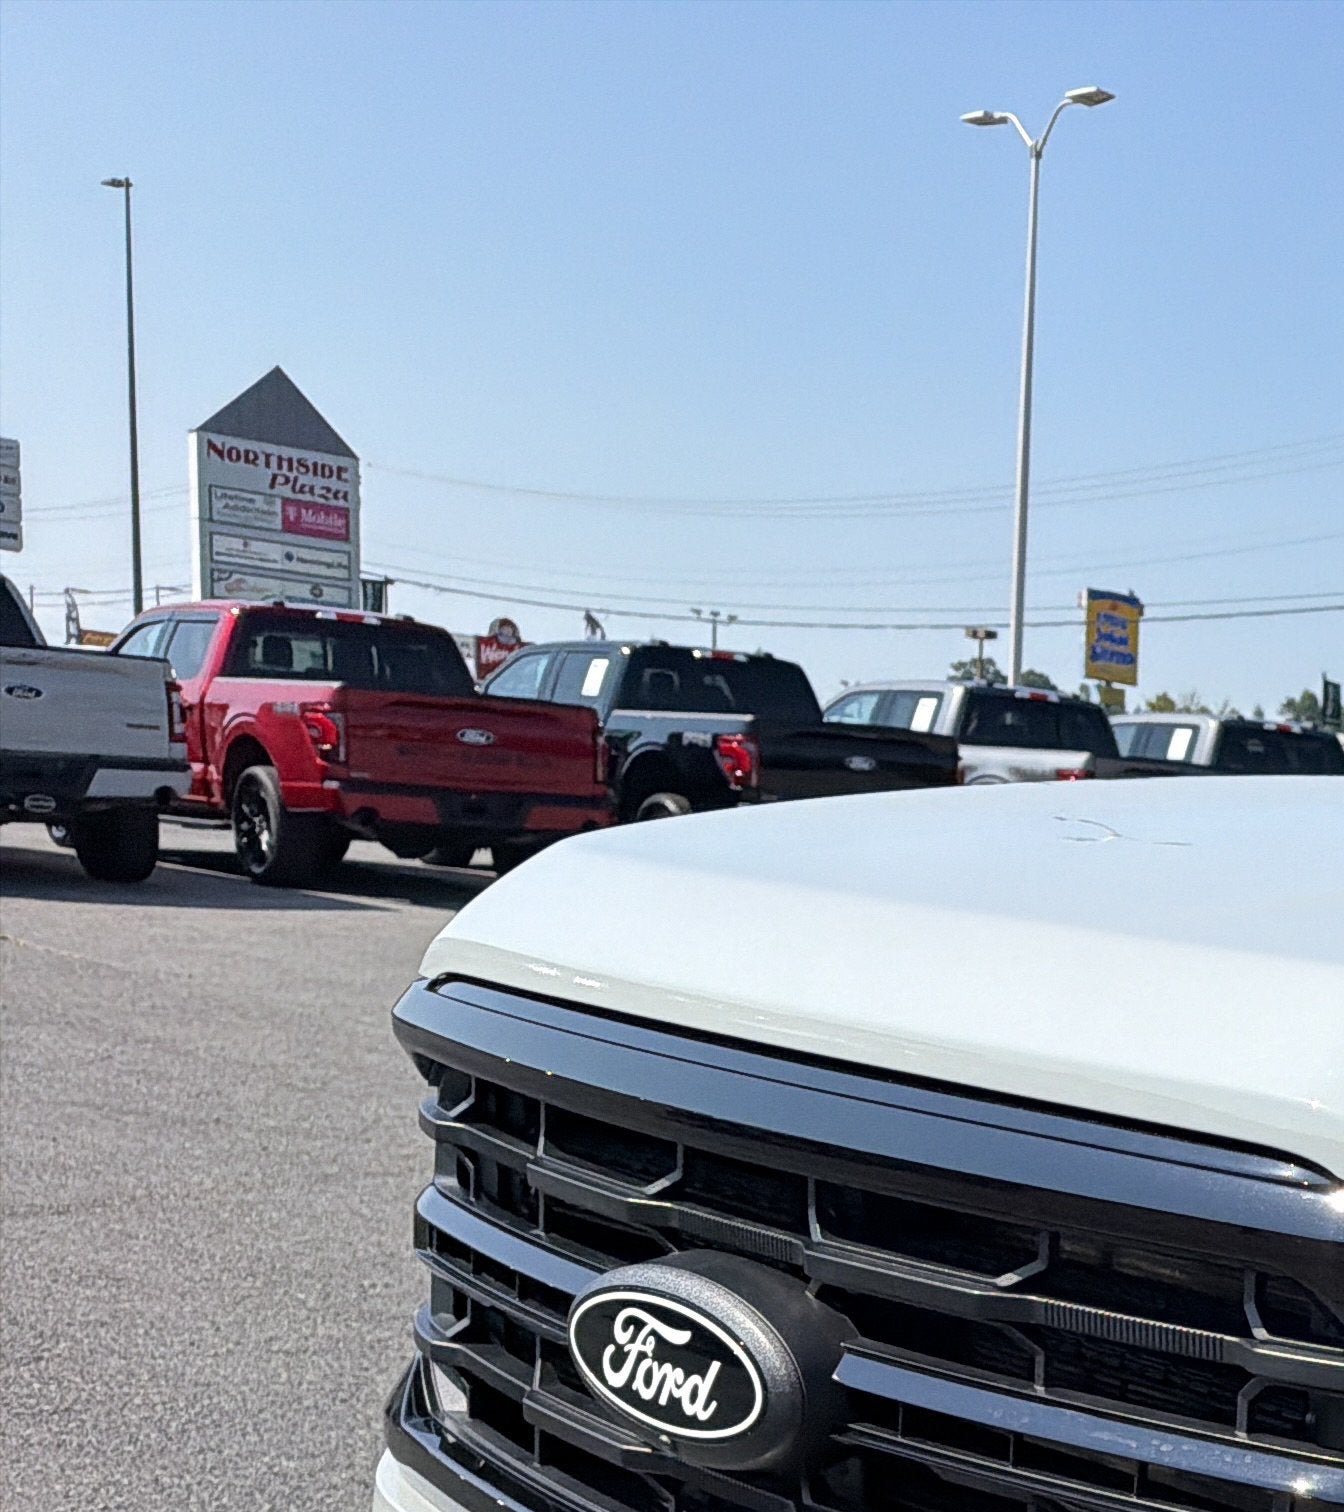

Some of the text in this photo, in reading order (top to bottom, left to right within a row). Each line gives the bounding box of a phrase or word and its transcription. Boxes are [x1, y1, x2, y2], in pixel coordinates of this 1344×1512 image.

[207, 439, 349, 483] NORTHSIDE
[269, 472, 349, 502] Plaza
[602, 1306, 722, 1421] Ford
